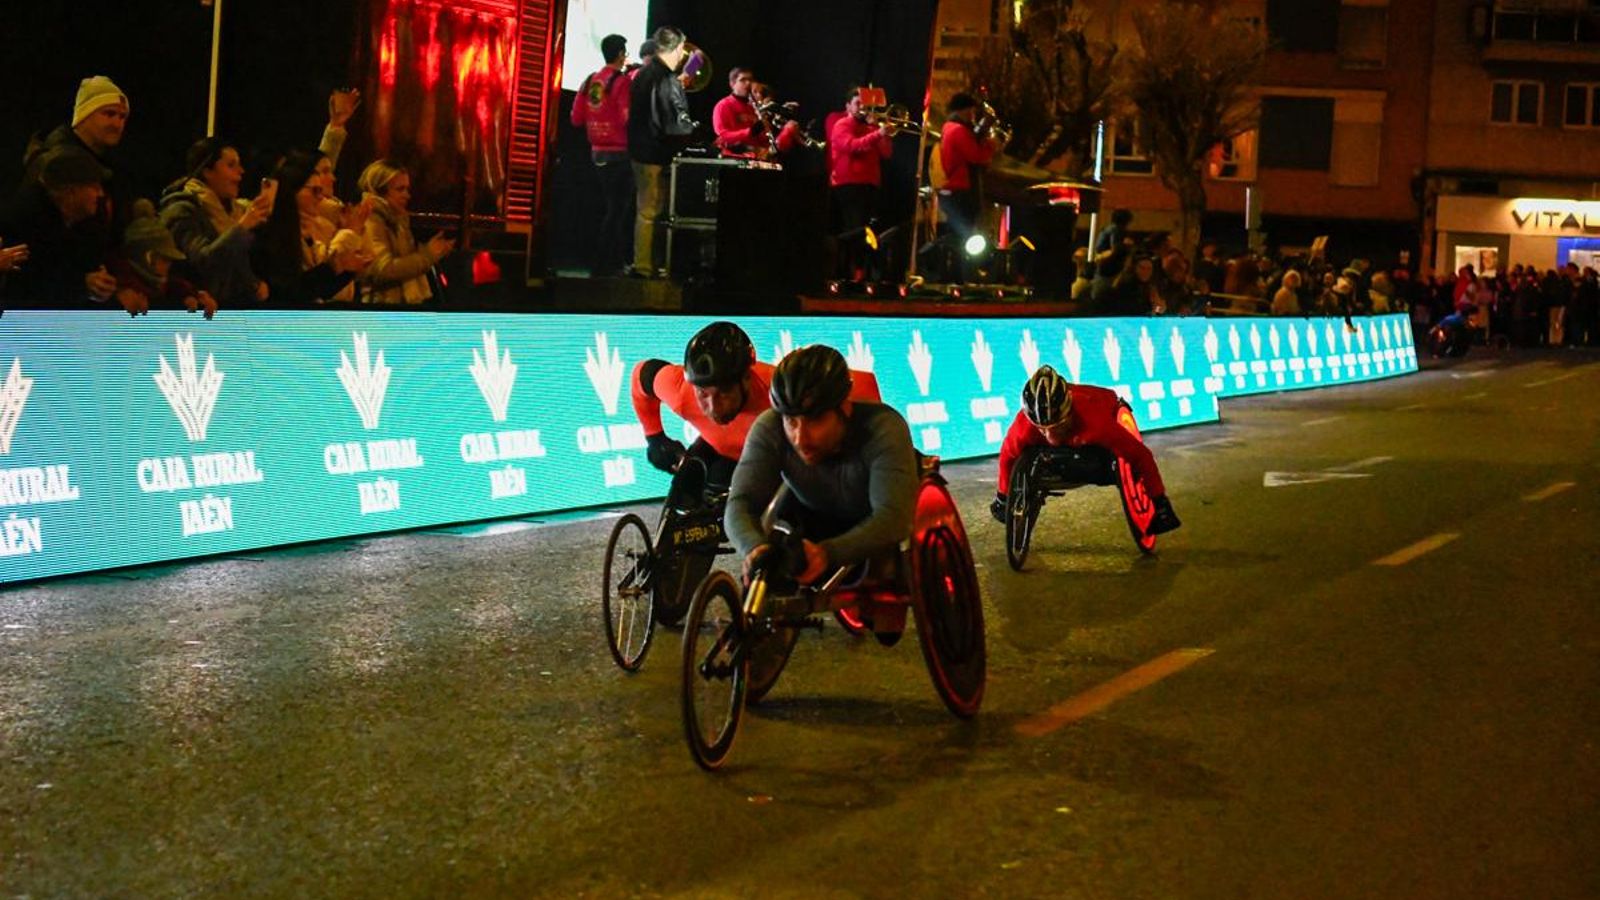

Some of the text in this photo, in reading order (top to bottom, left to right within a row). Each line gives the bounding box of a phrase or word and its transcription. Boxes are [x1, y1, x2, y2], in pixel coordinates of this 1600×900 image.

[1512, 210, 1600, 233] VITAL
[137, 450, 264, 493] CAJA RURAL
[324, 438, 423, 474] CAJA RURAL
[357, 477, 400, 514] JAÉN
[180, 493, 234, 537] JAÉN
